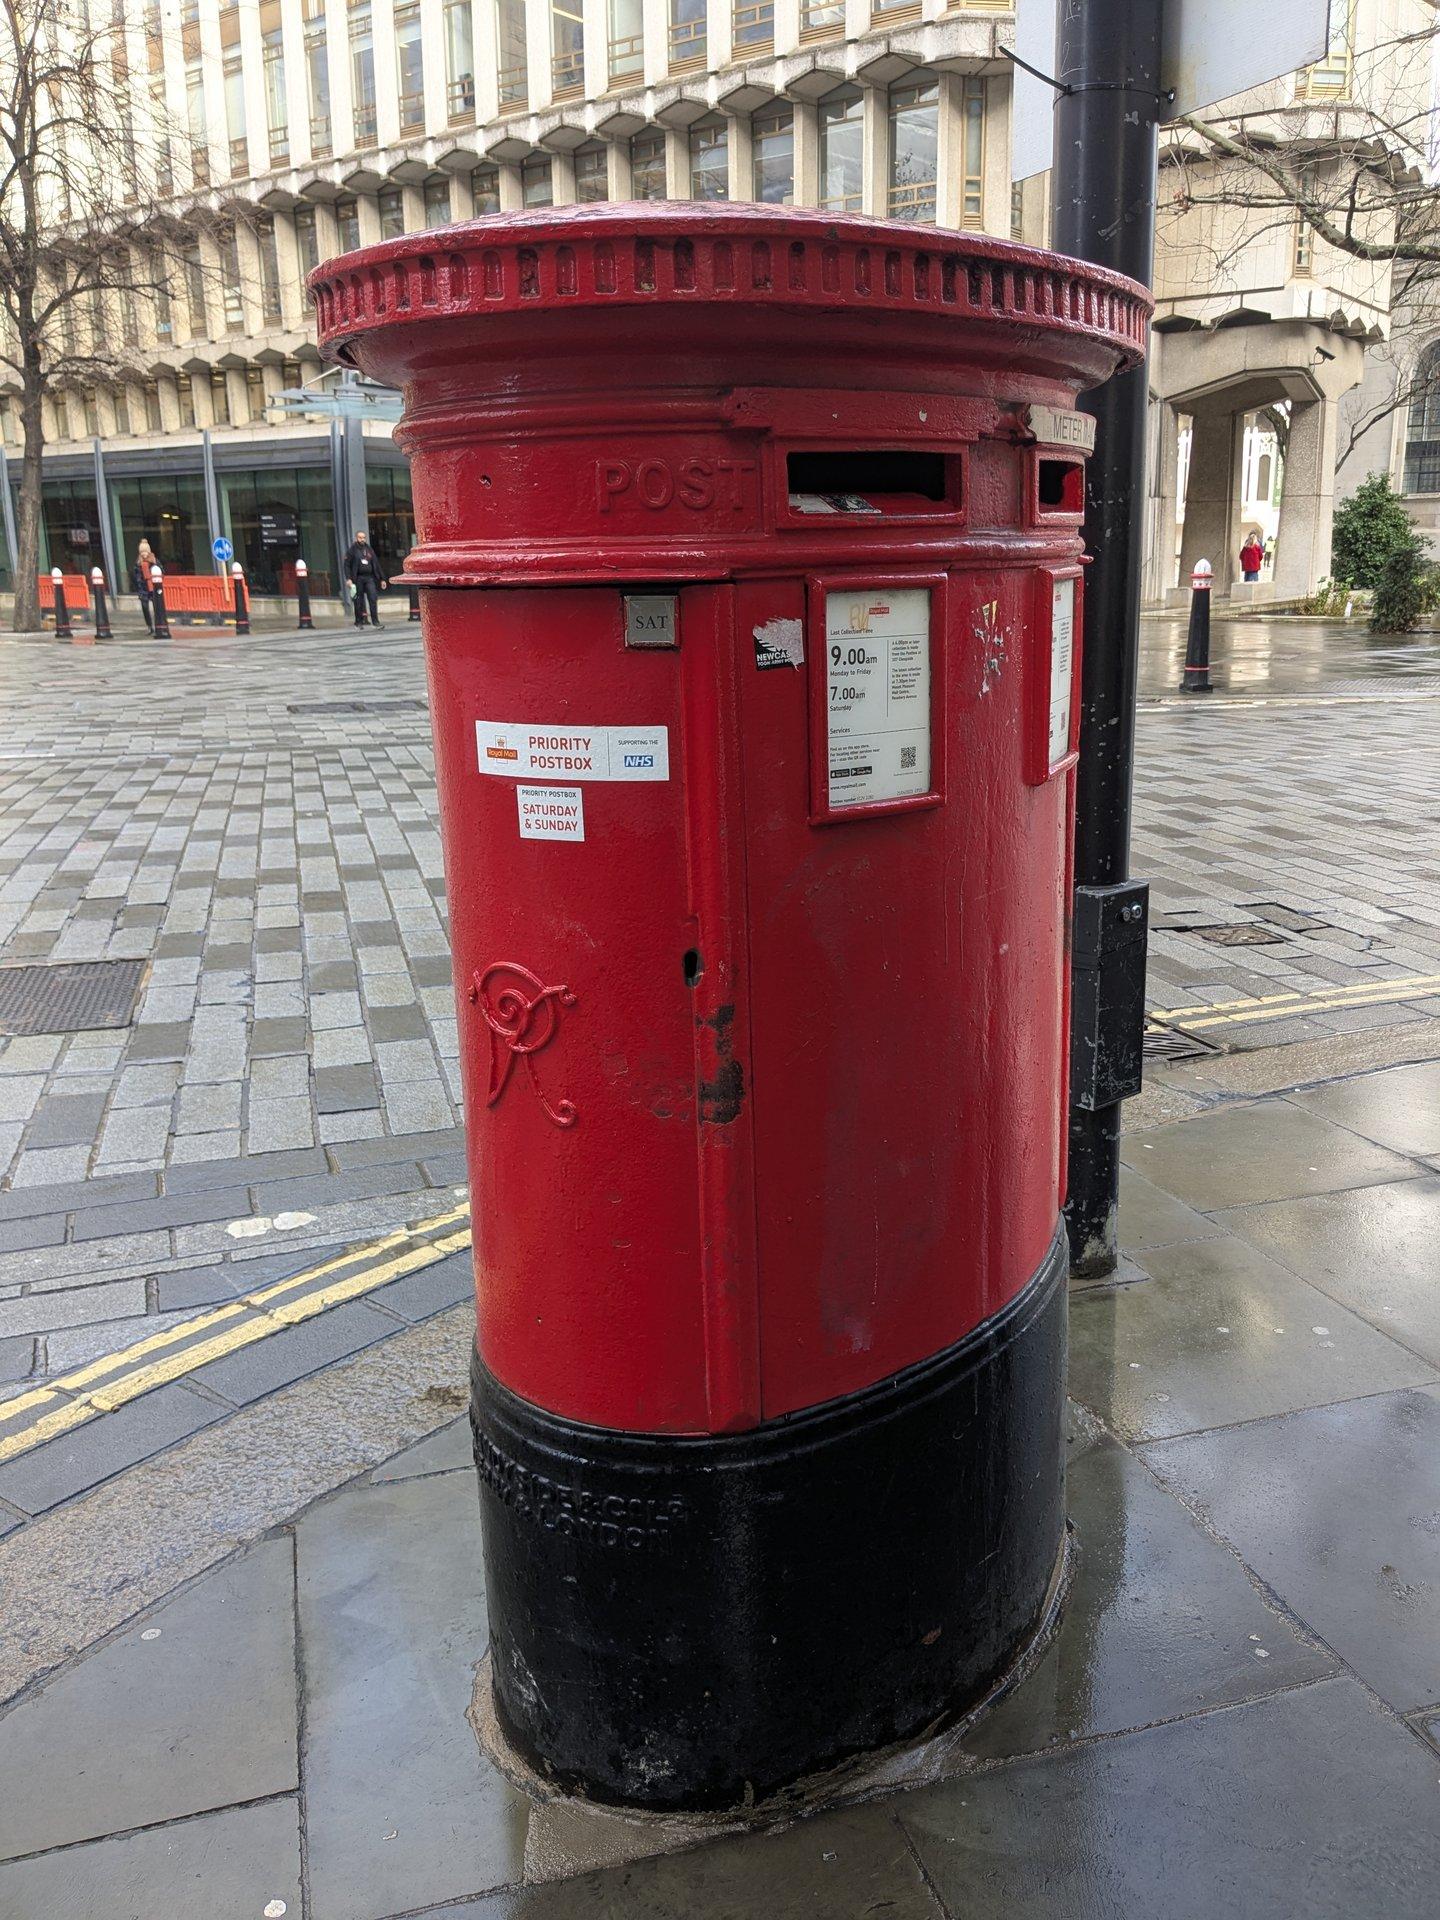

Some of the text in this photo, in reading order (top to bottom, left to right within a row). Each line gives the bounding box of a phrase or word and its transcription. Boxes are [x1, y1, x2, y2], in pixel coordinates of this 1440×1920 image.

[1053, 414, 1082, 443] METER
[593, 456, 756, 513] POST
[634, 614, 668, 630] SAT
[830, 645, 878, 667] 9.00am
[856, 668, 872, 676] Friday
[830, 686, 866, 701] 7.00am
[830, 704, 852, 712] Saturday
[829, 727, 851, 735] Services
[528, 736, 592, 751] PRIORITY
[488, 748, 517, 759] Royal Mail
[625, 755, 653, 767] NHS
[530, 756, 592, 771] POSTBOX
[521, 789, 577, 798] PRIORITY POSTBOX
[522, 803, 578, 818] SATURDAY
[524, 819, 578, 832] & SUNDAY
